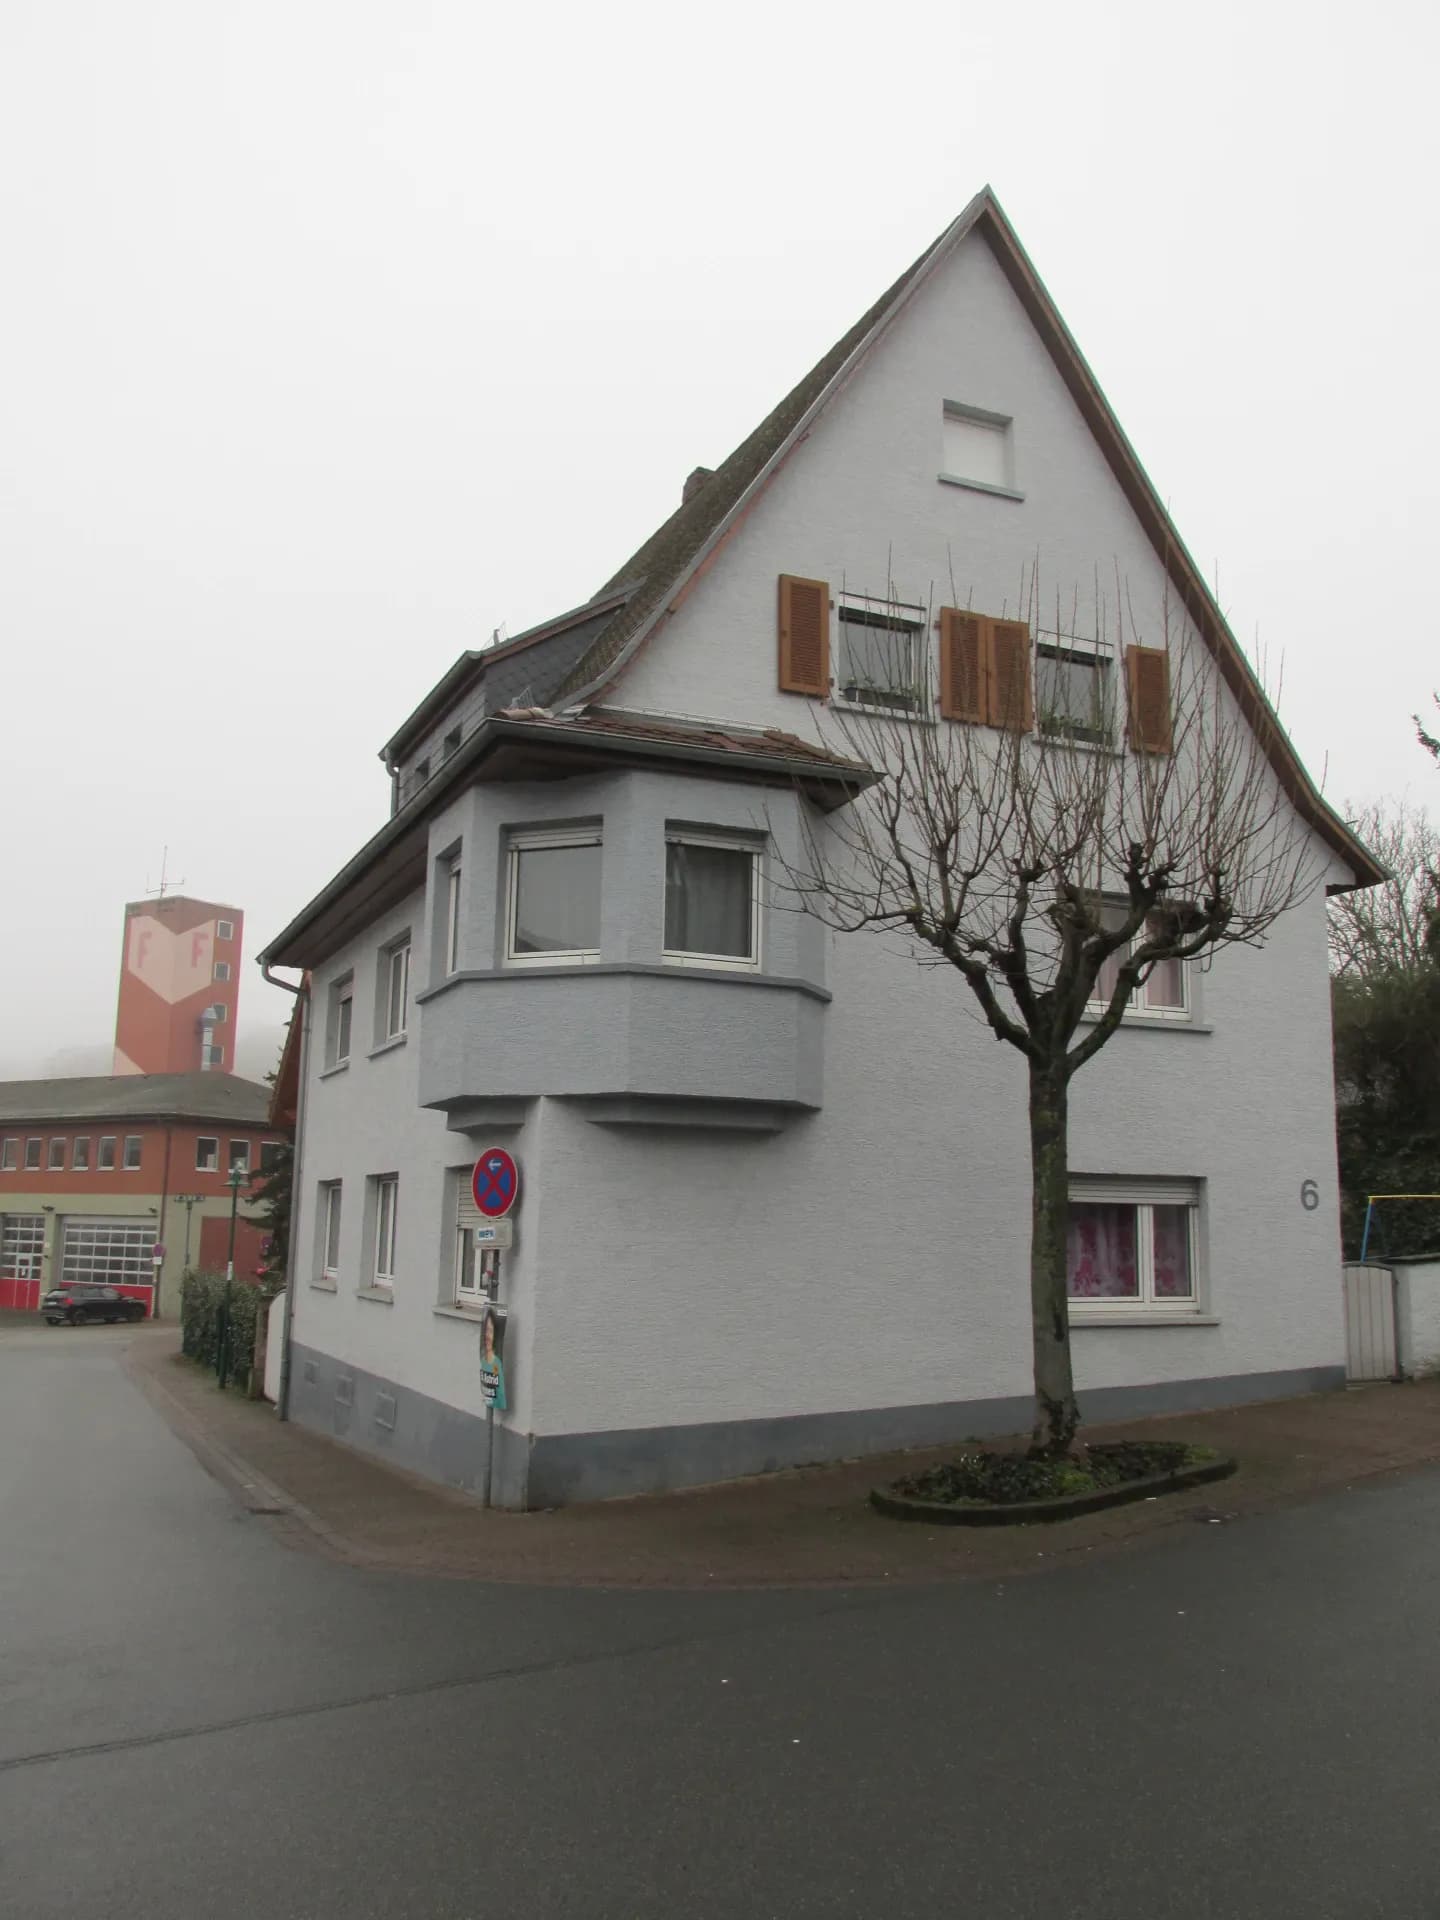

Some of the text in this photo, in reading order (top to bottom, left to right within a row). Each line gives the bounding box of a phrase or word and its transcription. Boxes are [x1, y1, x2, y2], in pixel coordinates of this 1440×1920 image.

[137, 931, 209, 968] F F
[1300, 1179, 1319, 1211] 6
